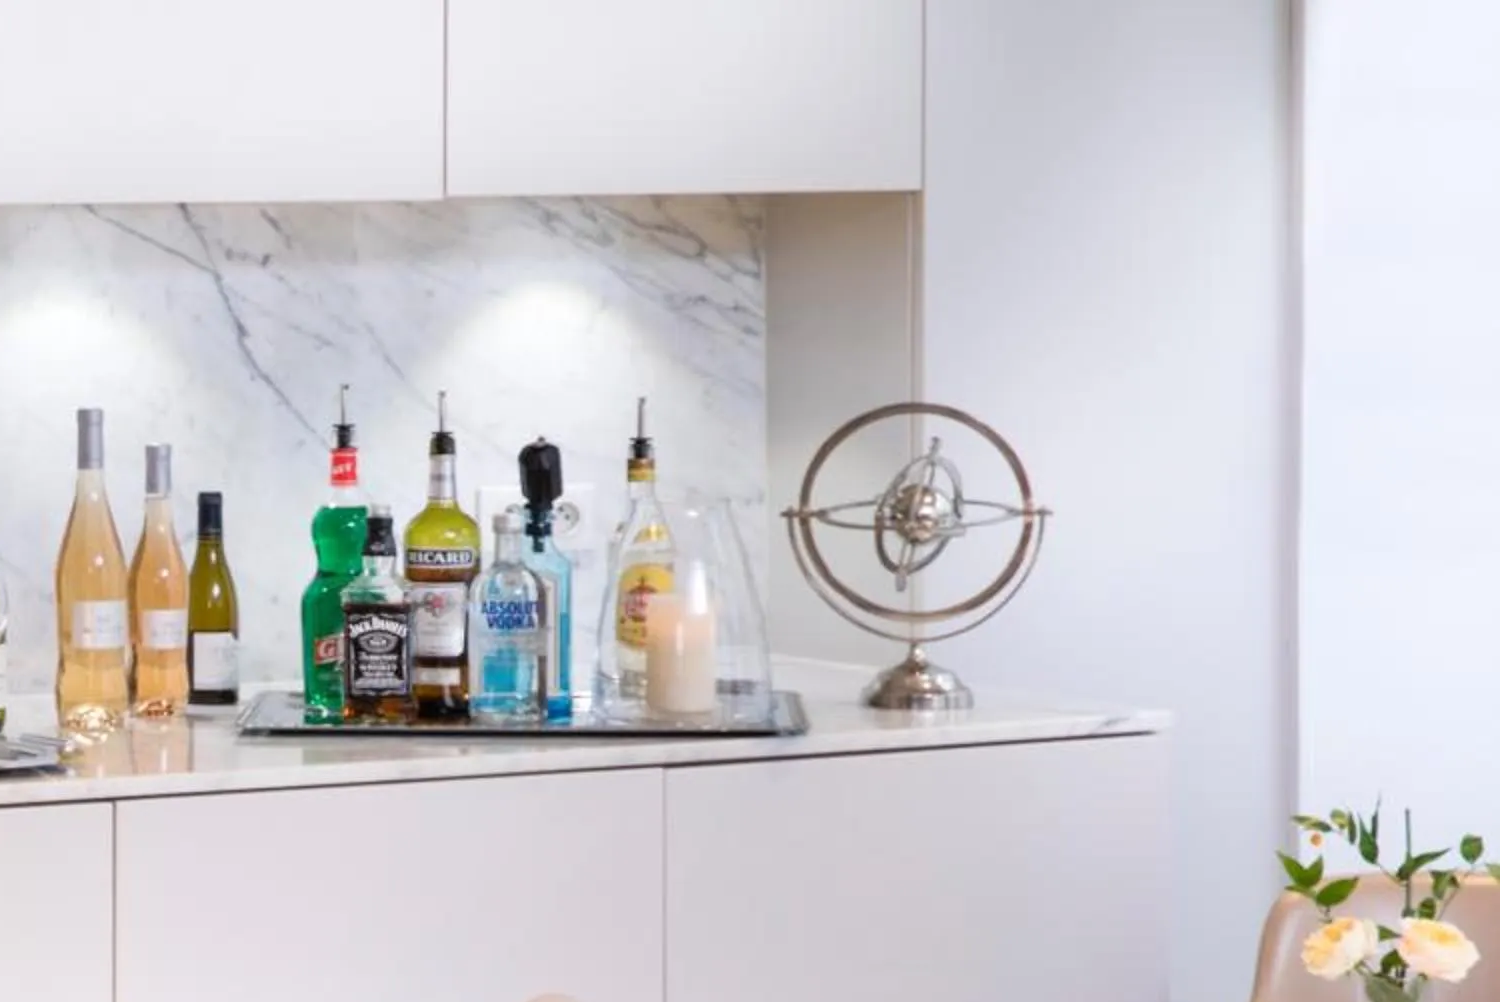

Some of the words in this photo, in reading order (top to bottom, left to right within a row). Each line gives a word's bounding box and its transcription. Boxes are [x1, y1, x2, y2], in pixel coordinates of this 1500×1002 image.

[408, 551, 471, 563] RICARD
[482, 601, 538, 613] ABSOLUT
[487, 614, 536, 629] VODKA
